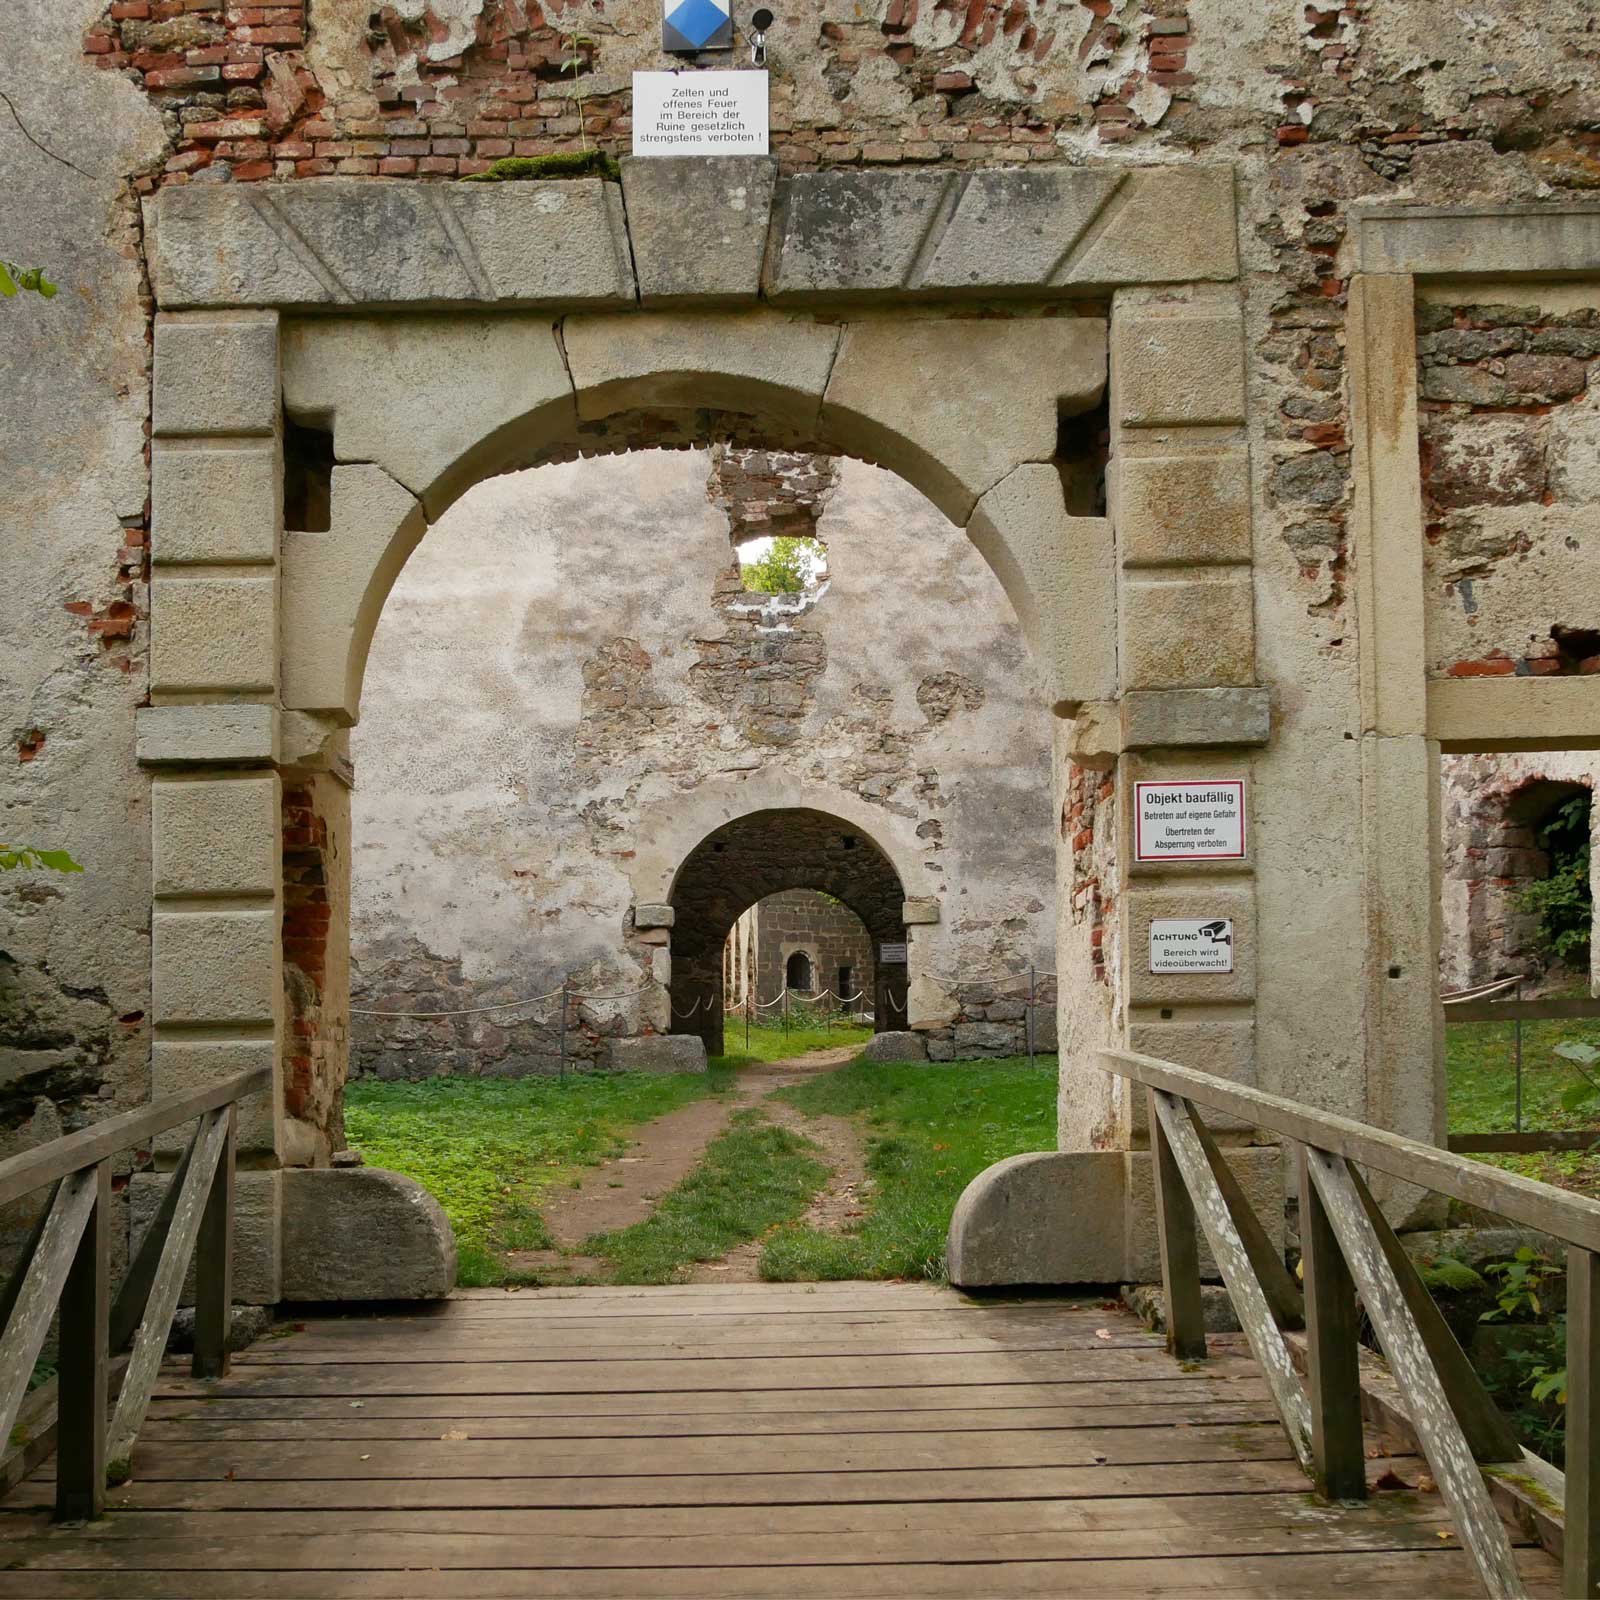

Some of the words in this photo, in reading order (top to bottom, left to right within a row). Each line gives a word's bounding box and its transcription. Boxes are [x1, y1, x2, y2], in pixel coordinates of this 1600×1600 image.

[672, 88, 704, 98] Zelten
[709, 87, 729, 97] und
[662, 100, 703, 109] offenes
[707, 99, 738, 108] Feuer
[660, 111, 673, 120] im
[677, 111, 718, 120] Bereich
[722, 110, 740, 119] der
[656, 122, 686, 131] Ruine
[690, 121, 745, 132] gesetzlich
[639, 133, 702, 144] strengstens
[707, 132, 754, 142] verboten
[1146, 792, 1183, 806] Objekt
[1185, 791, 1234, 804] baufällig
[1144, 810, 1174, 820] Betreten
[1175, 810, 1187, 819] auf
[1188, 810, 1212, 820] eigene
[1213, 809, 1236, 819] Gefahr
[1165, 826, 1202, 836] Übertreten
[1203, 827, 1216, 836] der
[1154, 839, 1195, 850] Absperrung
[1196, 839, 1227, 848] verboten
[1152, 933, 1198, 941] ACHTUNG
[1163, 948, 1197, 957] Bereich
[1199, 948, 1219, 956] wird
[1154, 959, 1228, 967] videoüberwacht!
